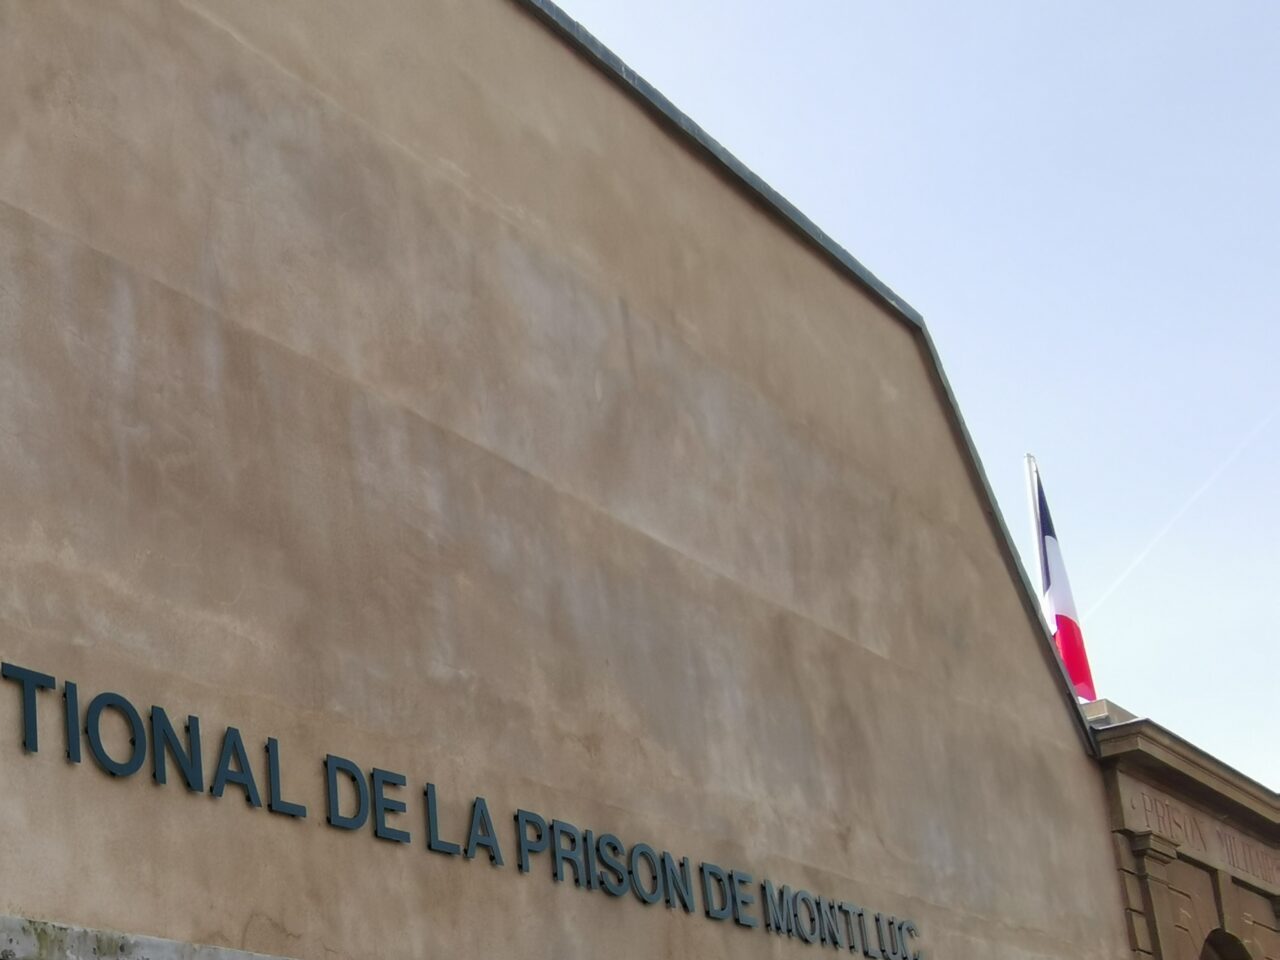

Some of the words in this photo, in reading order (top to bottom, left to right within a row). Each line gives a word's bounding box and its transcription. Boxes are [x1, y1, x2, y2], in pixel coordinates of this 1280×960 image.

[325, 753, 411, 844] DE
[425, 782, 504, 867] LA
[515, 808, 695, 913] PRISON
[702, 862, 758, 928] DE
